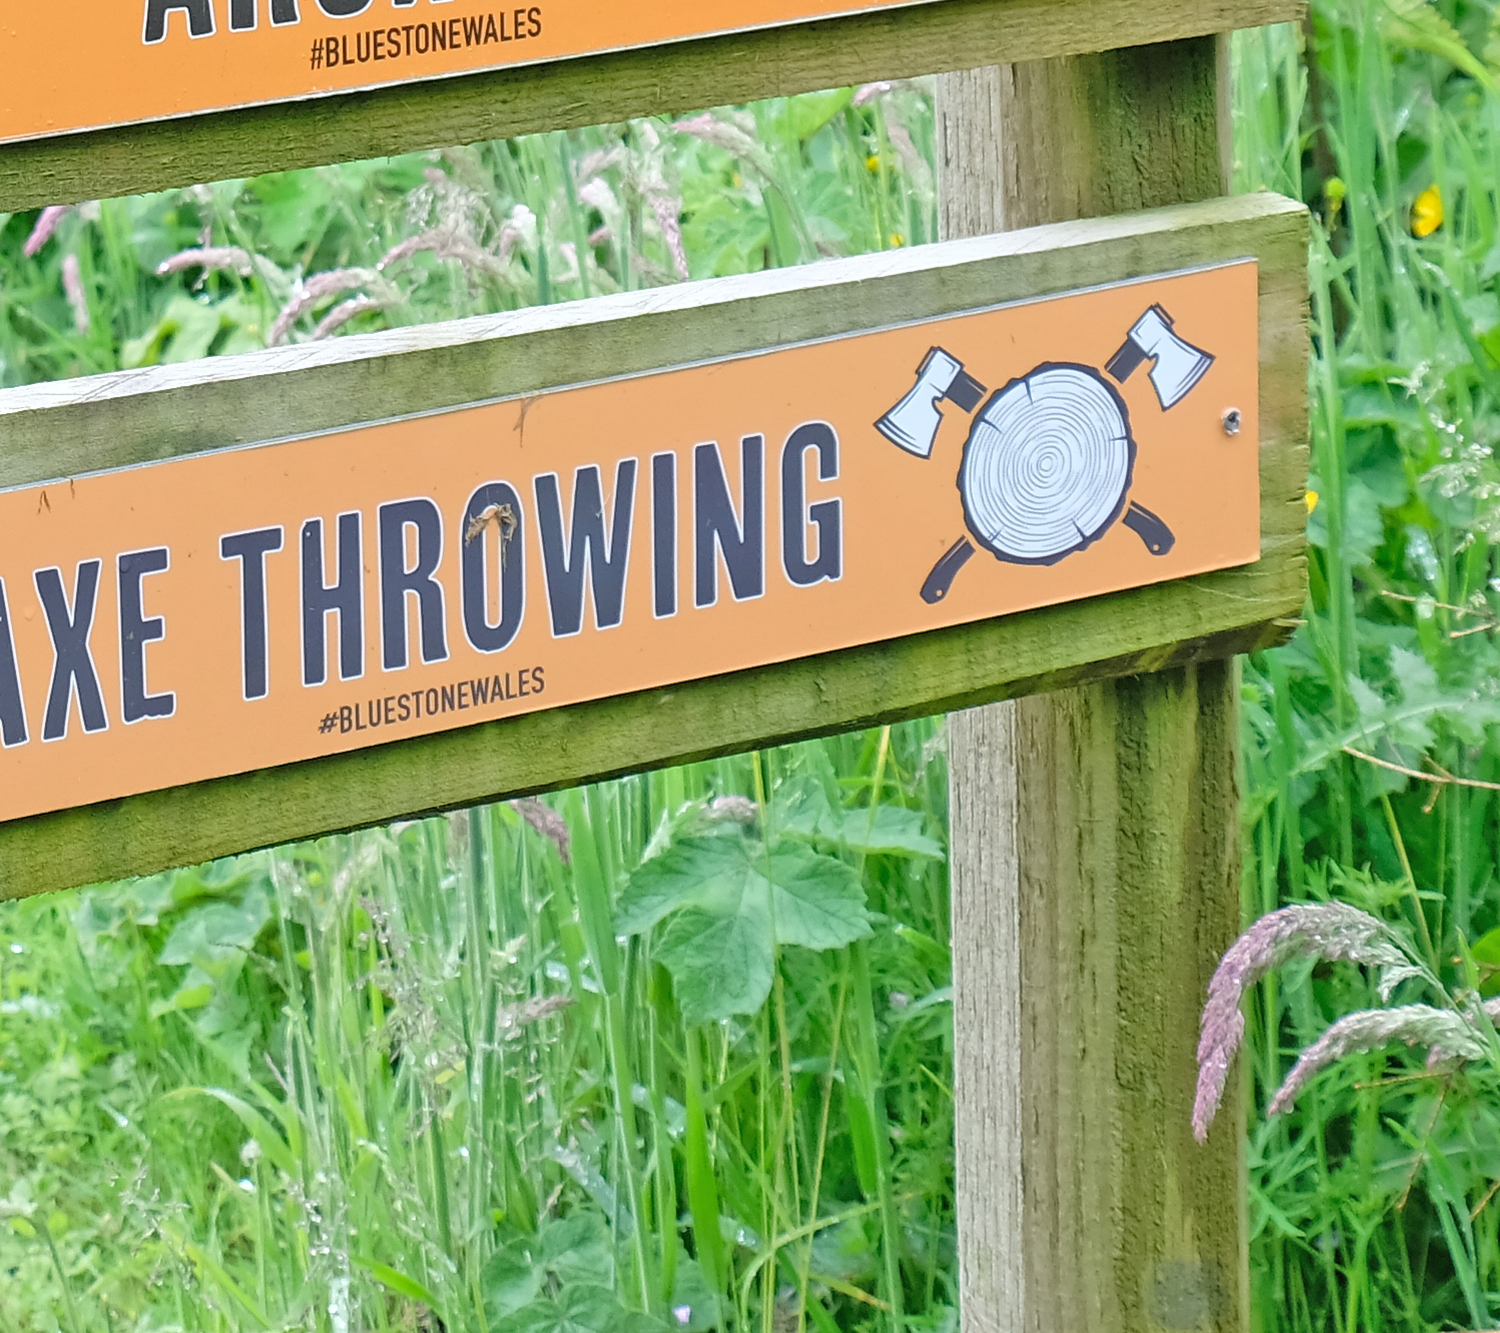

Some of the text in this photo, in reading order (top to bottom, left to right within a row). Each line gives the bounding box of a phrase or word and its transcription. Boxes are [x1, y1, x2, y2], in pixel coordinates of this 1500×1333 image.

[308, 5, 543, 72] #BLUESTONEWALES
[218, 419, 844, 703] THROWING
[317, 665, 546, 735] #BLUESTONEWALES
